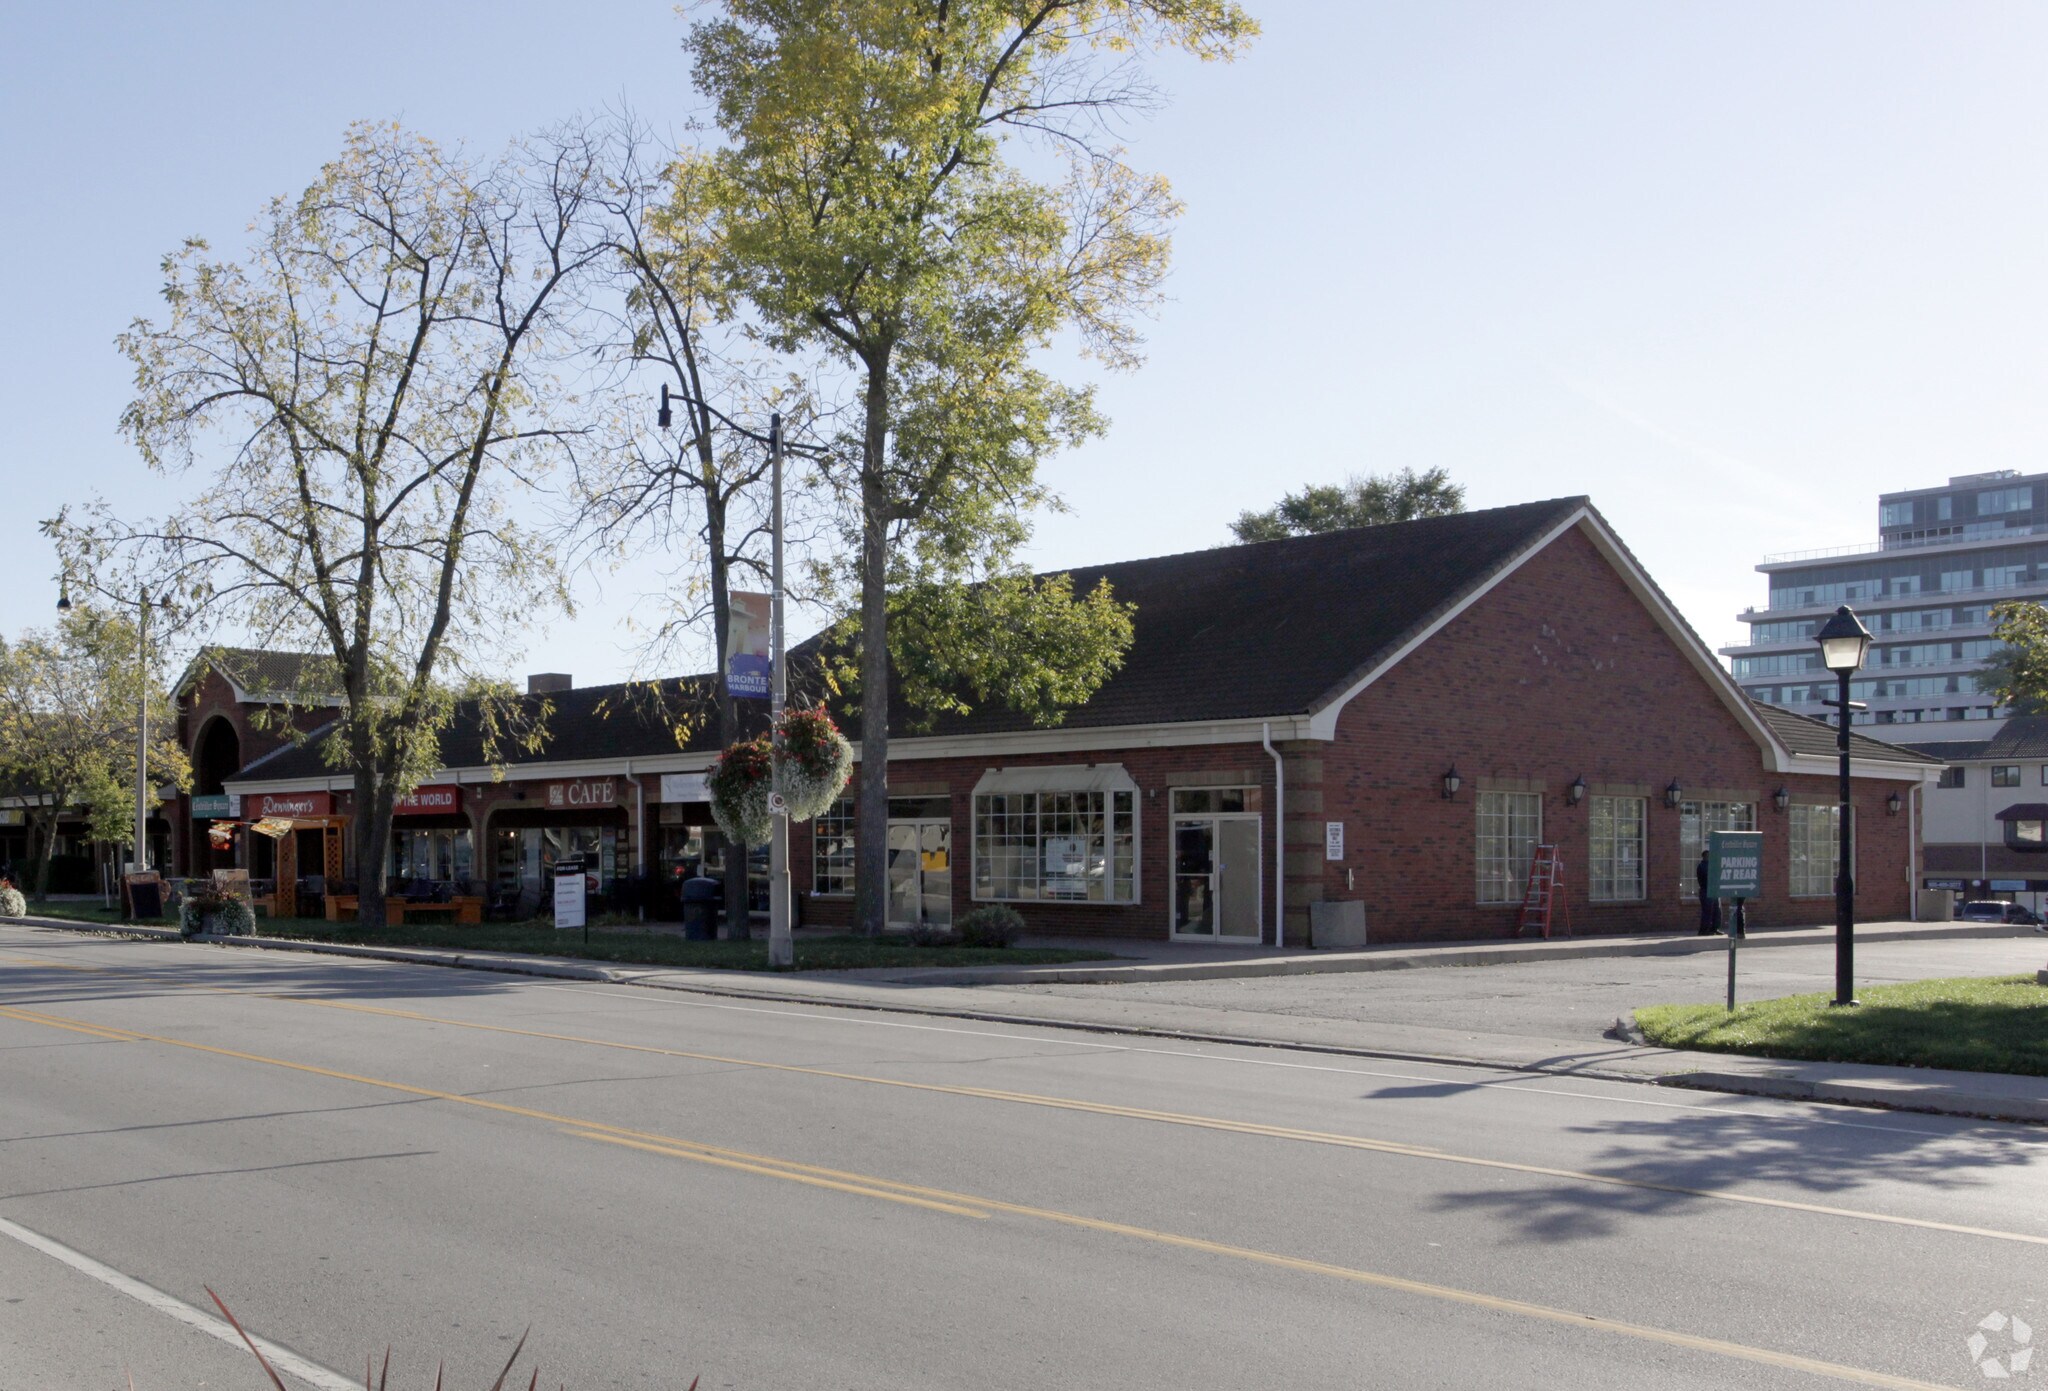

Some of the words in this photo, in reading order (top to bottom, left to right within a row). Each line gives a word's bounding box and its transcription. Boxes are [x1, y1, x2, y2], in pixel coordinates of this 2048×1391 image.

[727, 674, 767, 686] BRONTE
[728, 684, 767, 693] HARBOUR
[568, 777, 614, 804] CAFÉ
[403, 794, 419, 807] THE
[420, 793, 452, 806] WORLD
[261, 796, 314, 817] Denninger's
[1721, 856, 1758, 868] PARKING
[1720, 868, 1732, 880] AT
[1733, 868, 1757, 880] REAR
